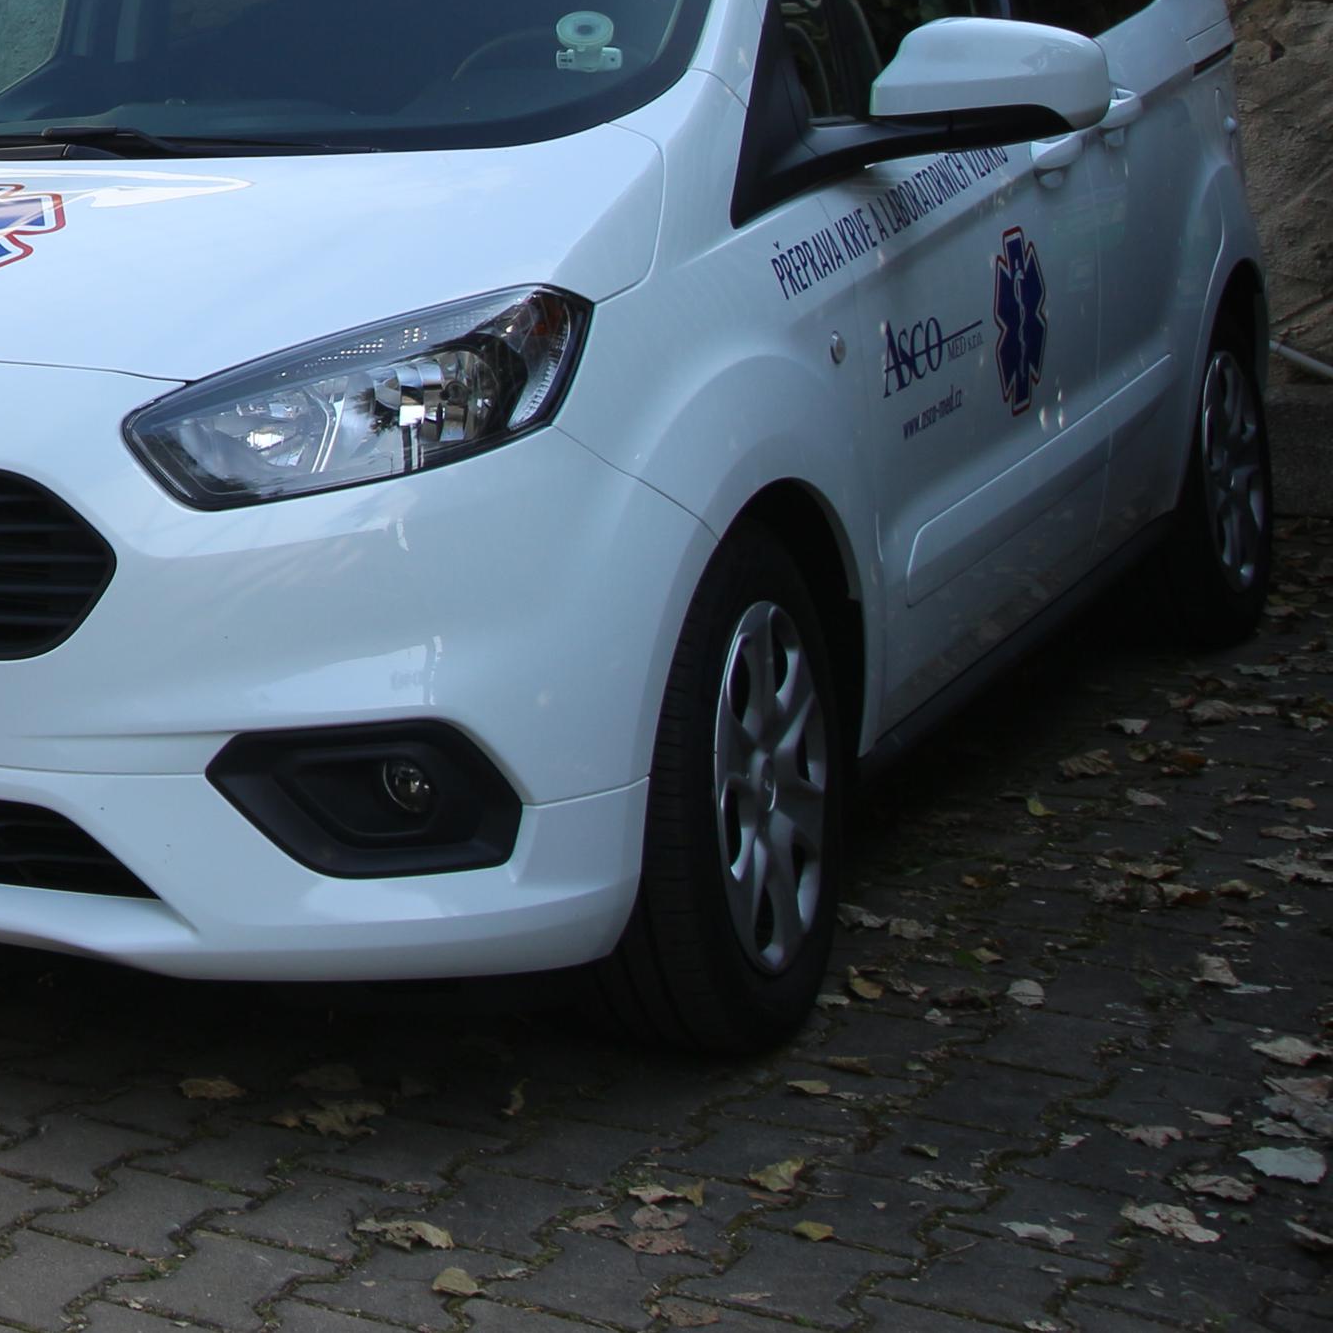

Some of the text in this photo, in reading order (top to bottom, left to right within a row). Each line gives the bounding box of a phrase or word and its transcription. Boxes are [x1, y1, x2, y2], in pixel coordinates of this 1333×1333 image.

[771, 228, 846, 300] PŘEPRAVA
[834, 208, 877, 262] KRVE
[867, 202, 890, 243] A
